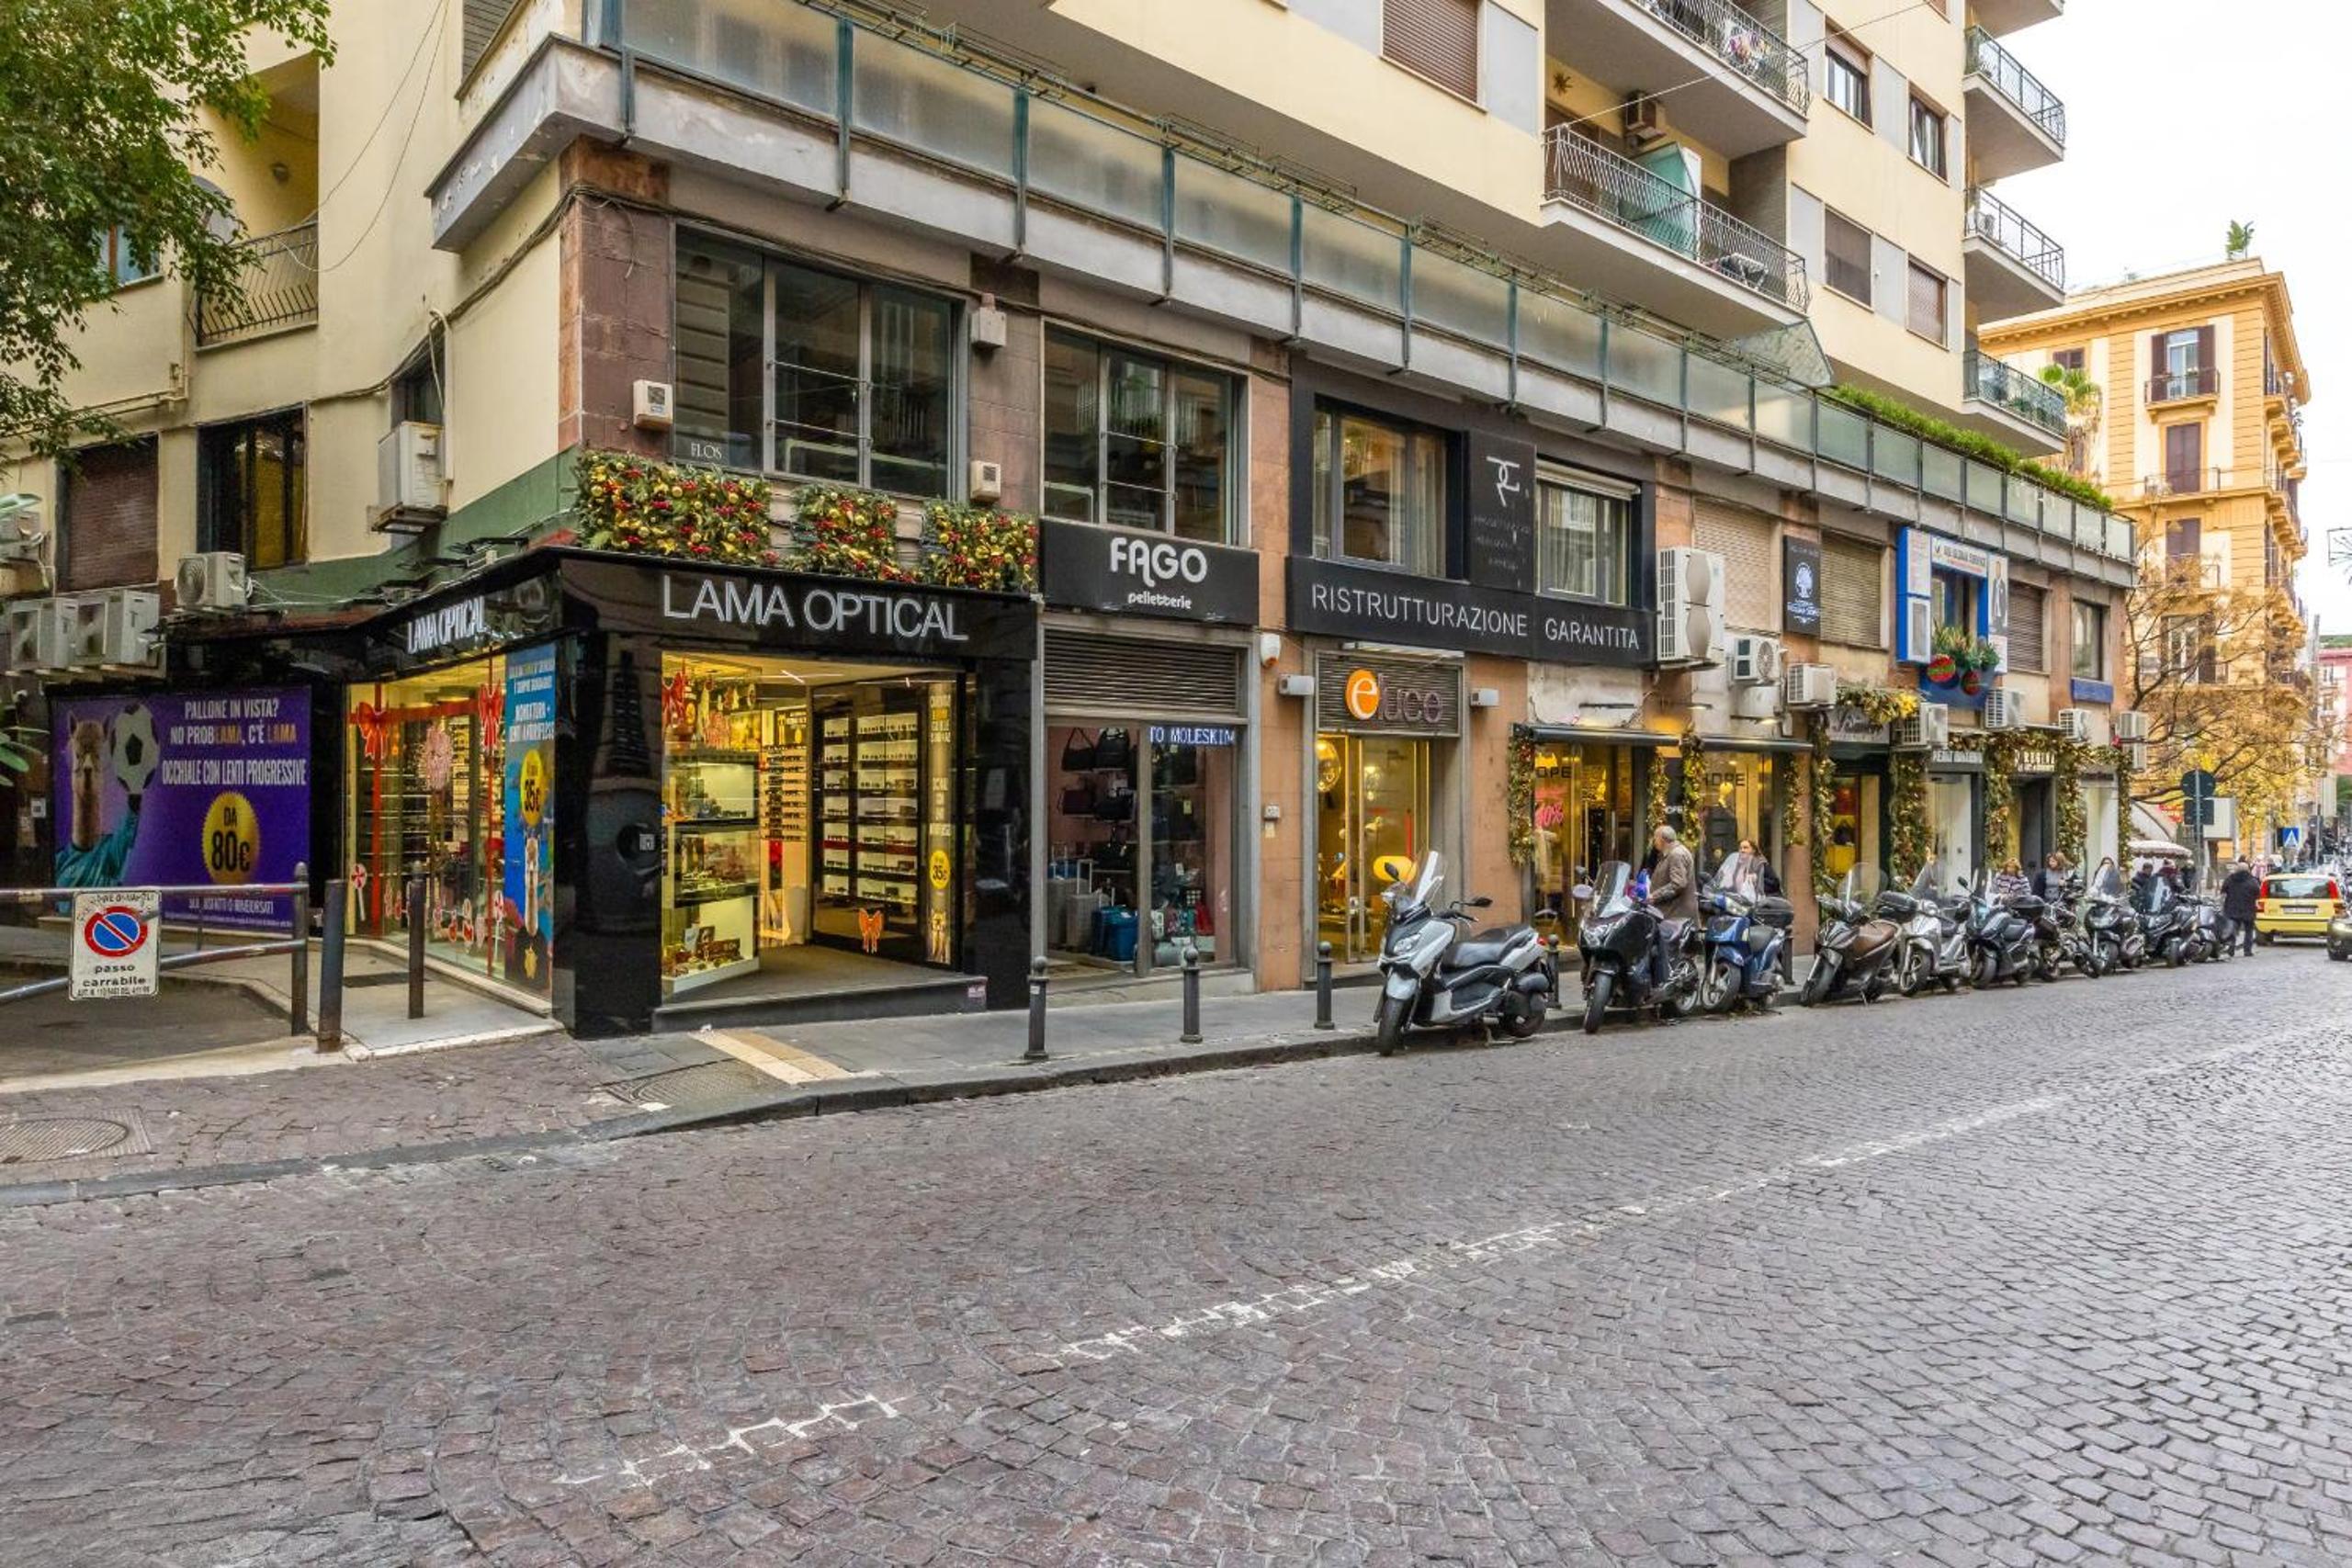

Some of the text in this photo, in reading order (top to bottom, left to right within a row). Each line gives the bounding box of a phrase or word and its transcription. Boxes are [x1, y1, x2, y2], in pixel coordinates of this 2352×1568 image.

[1110, 537, 1207, 588] FAGO
[663, 575, 969, 640] LAMA OPTICAL
[1127, 591, 1193, 609] pelletterie
[408, 595, 489, 654] LAMA OPTICAL
[1312, 583, 1639, 650] RISTRUTTURAZIONE GARANTITA
[185, 698, 279, 719] PALLONE IN VISTA?
[170, 727, 184, 744] NO
[267, 724, 298, 744] LAMA
[162, 760, 306, 785] OCCHIALE CON LENTI PROGRESSIVE
[224, 807, 237, 828] DA
[212, 830, 250, 872] 80€
[95, 964, 136, 974] passo
[83, 976, 146, 987] carrabile
